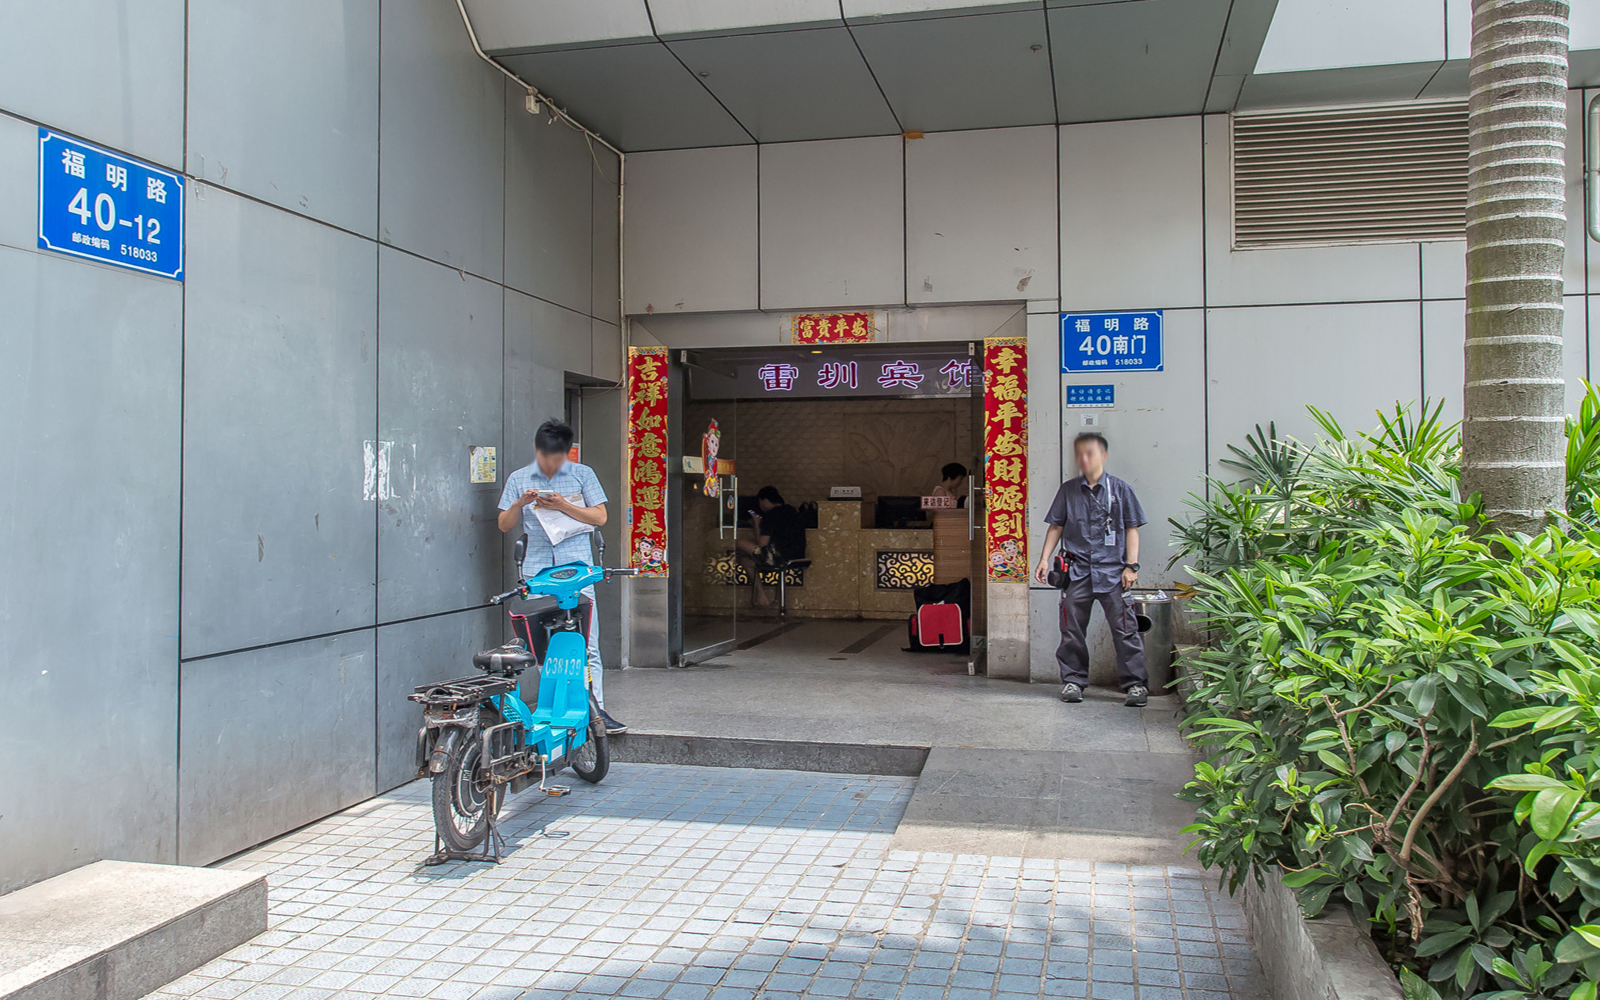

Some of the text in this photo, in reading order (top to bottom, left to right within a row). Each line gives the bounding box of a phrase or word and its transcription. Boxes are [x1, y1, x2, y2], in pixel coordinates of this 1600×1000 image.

[61, 148, 167, 204] 福明路
[67, 187, 161, 245] 40-12
[72, 231, 158, 263] 邮政编码 518033
[1074, 317, 1150, 333] 福明路
[1078, 334, 1146, 356] 40南门
[1115, 358, 1144, 366] 518033
[922, 496, 950, 508] 来访登记
[545, 657, 582, 677] C38139
